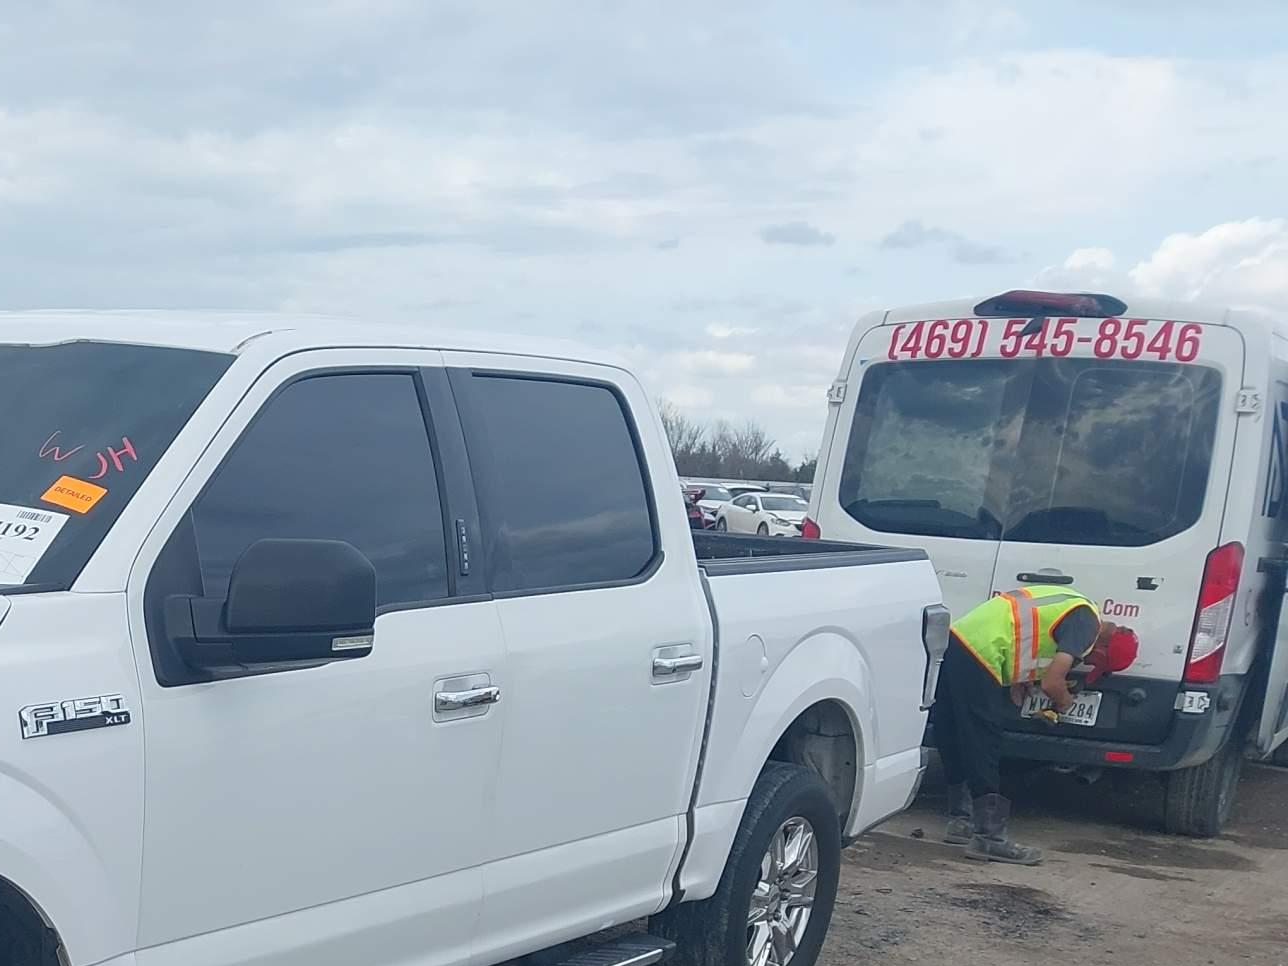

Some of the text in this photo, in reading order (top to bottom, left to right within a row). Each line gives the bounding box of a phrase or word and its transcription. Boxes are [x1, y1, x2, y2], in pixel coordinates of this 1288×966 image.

[887, 318, 1202, 363] (469) 545-8546
[54, 486, 92, 502] DETAILED
[105, 714, 129, 725] XLT
